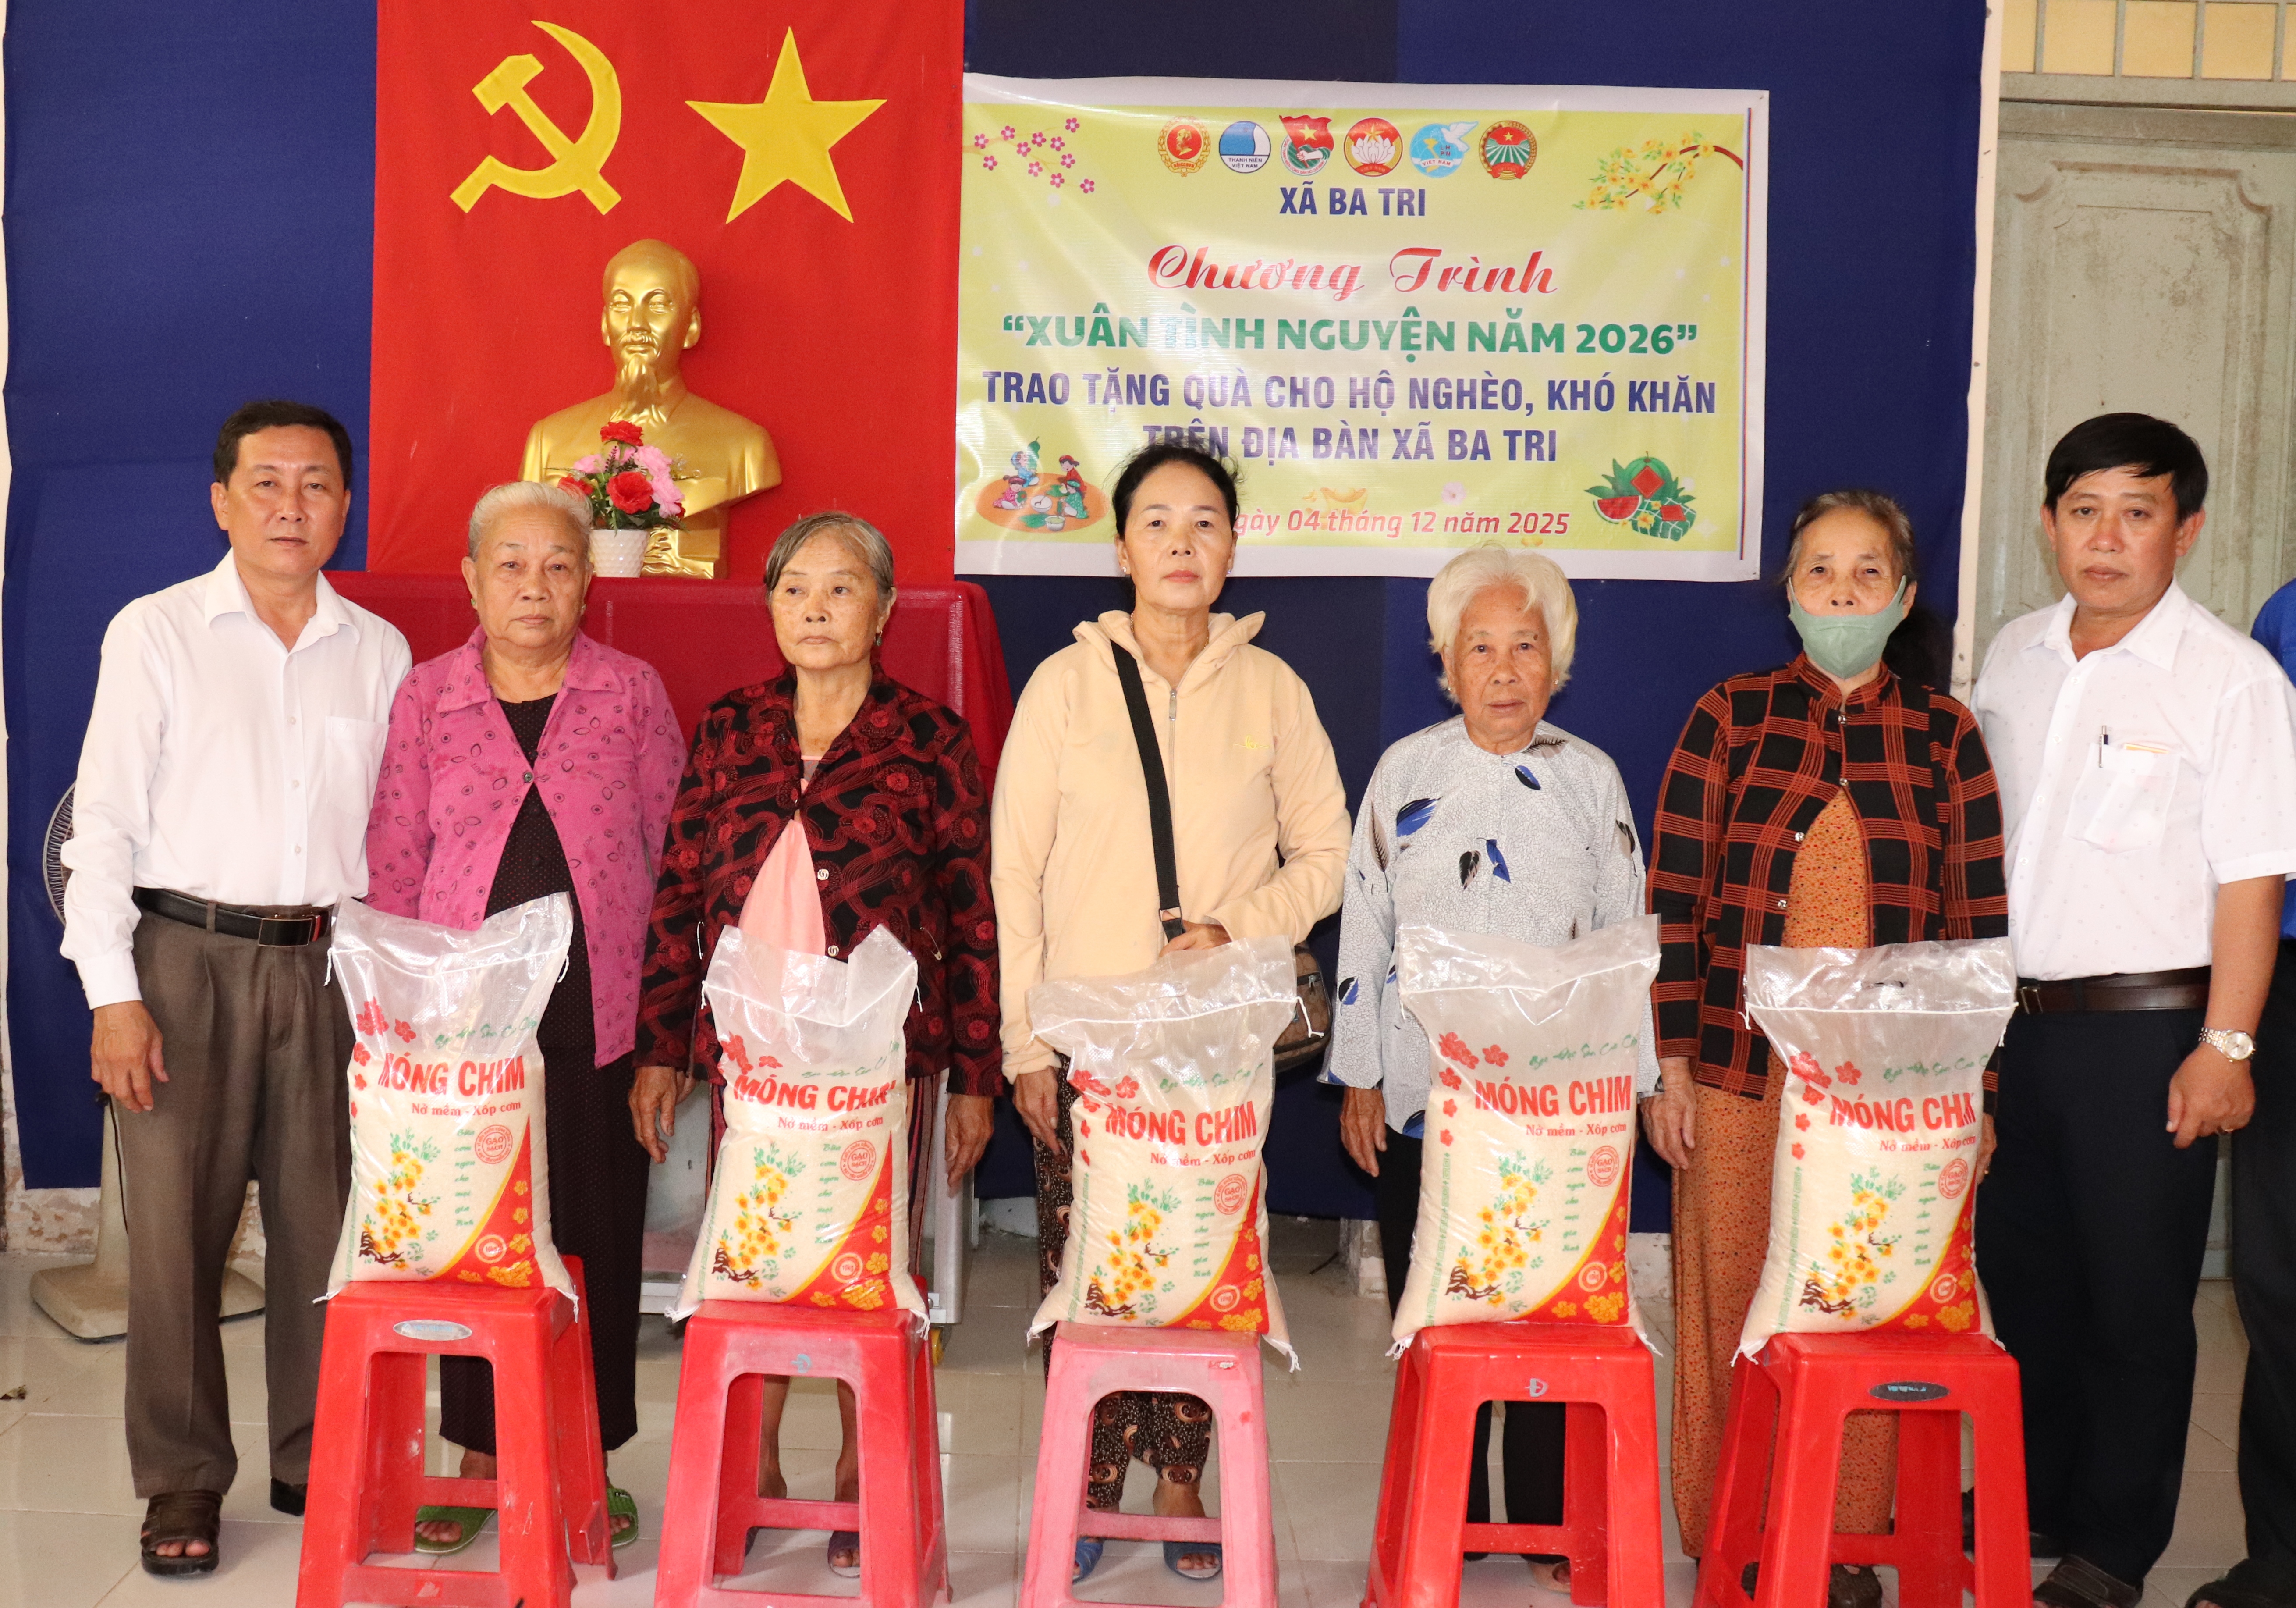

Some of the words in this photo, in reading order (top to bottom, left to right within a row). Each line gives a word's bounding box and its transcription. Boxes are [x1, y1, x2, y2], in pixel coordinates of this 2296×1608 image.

[1279, 181, 1317, 214] XÃ
[1329, 188, 1368, 215] BA
[1378, 188, 1426, 216] TRI
[1147, 245, 1365, 301] Chương
[1390, 246, 1558, 294] Trình
[1003, 302, 1148, 347] “XUÂN
[1160, 302, 1265, 349] TÌNH
[1277, 306, 1455, 363] NGUYỆN
[1468, 308, 1565, 353] NĂM
[1576, 324, 1697, 355] 2026”
[982, 371, 1070, 406] TRAO
[1082, 367, 1170, 413] TẶNG
[1183, 367, 1252, 411] QUÀ
[1265, 375, 1335, 409] CHO
[1349, 369, 1394, 416] HỘ
[1409, 371, 1533, 416] NGHÈO,
[1547, 372, 1615, 412] KHÓ
[1628, 375, 1716, 413] KHĂN
[1241, 426, 1299, 466] ĐỊA
[1313, 420, 1379, 460] BÀN
[1392, 421, 1442, 461] XÃ
[1448, 429, 1491, 461] BA
[1503, 429, 1556, 462] TRI
[1235, 509, 1281, 536] gày
[1288, 510, 1321, 531] 04
[1327, 509, 1401, 538] tháng
[1411, 511, 1437, 533] 12
[1443, 513, 1499, 534] năm
[1507, 512, 1570, 534] 2025
[458, 1055, 525, 1096] CHIM
[734, 1074, 819, 1110] MÓNG
[500, 1101, 521, 1112] cơm
[1475, 1076, 1559, 1117] MÓNG
[1569, 1075, 1632, 1116] CHIM
[1830, 1093, 1915, 1133] MÓNG
[840, 1117, 863, 1131] Xốp
[1106, 1102, 1186, 1146] MÓNG
[1195, 1101, 1256, 1146] CHIM
[1526, 1124, 1543, 1136] Nở
[1547, 1123, 1575, 1136] mềm
[1587, 1122, 1608, 1136] Xốp
[1611, 1123, 1626, 1133] cơm
[1213, 1149, 1235, 1165] Xốp
